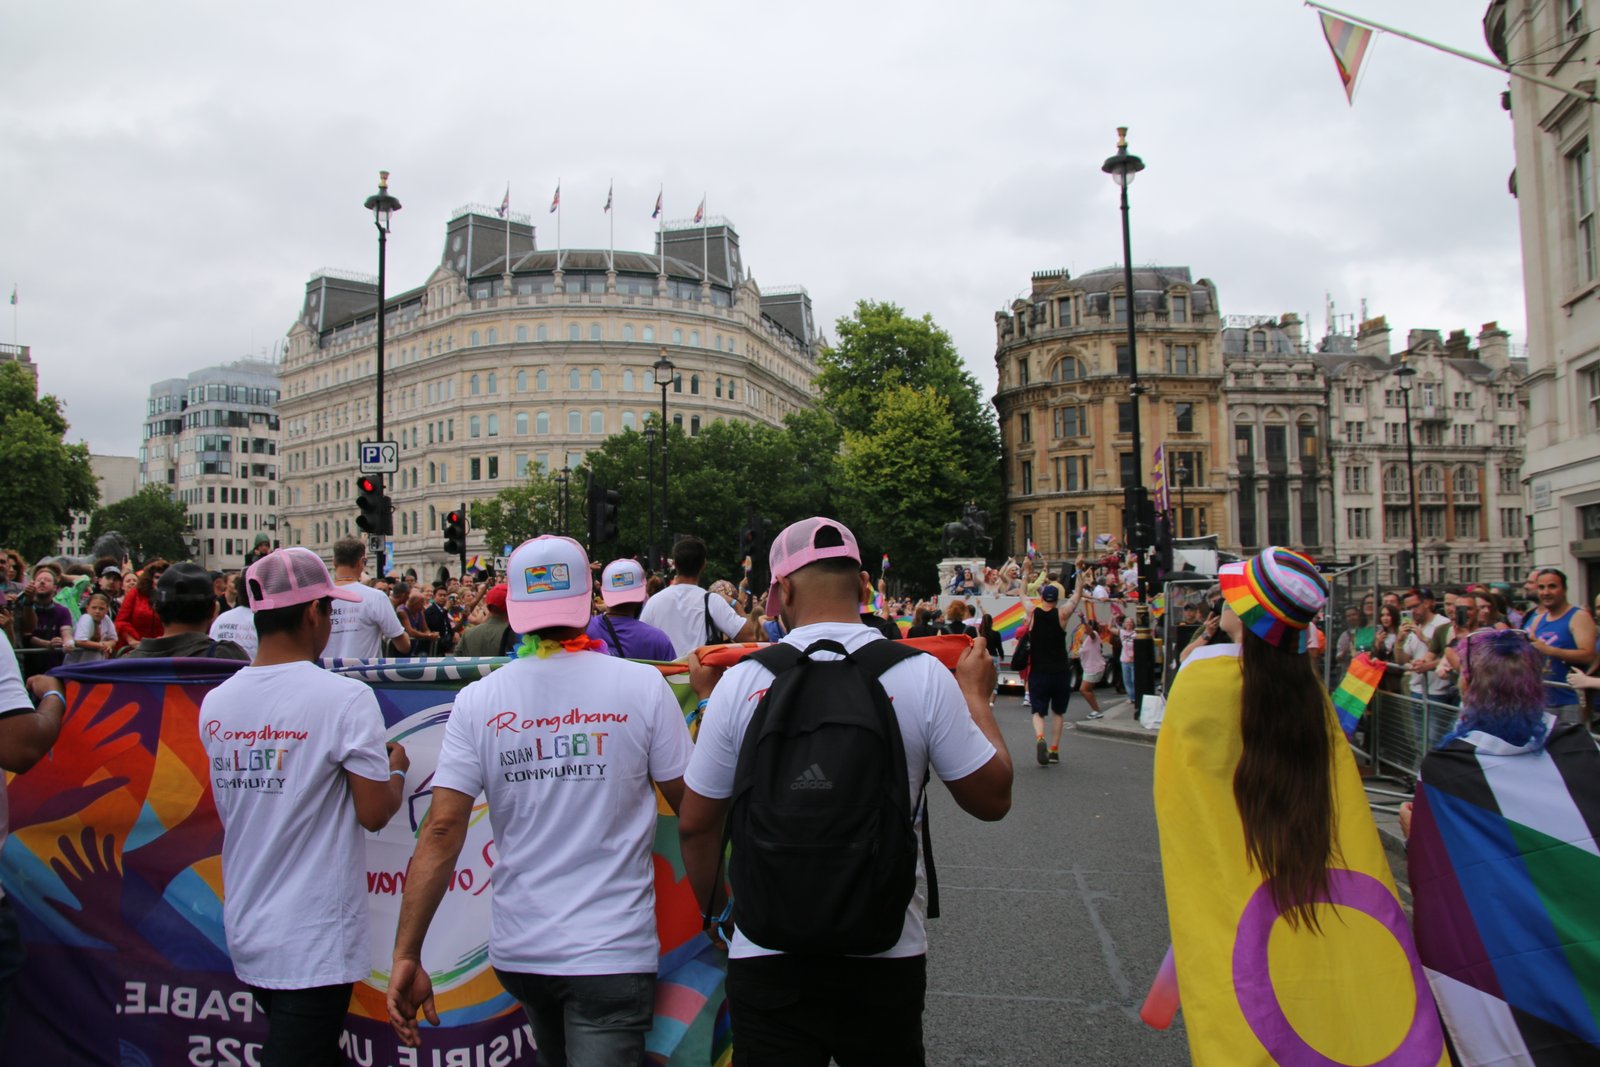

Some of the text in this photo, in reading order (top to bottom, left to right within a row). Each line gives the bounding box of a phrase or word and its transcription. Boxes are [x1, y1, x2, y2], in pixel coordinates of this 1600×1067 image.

[366, 447, 377, 462] P
[204, 719, 309, 747] Rongdhanu
[486, 707, 629, 737] Rongdhanu
[499, 732, 609, 767] ASIAN LGBT
[504, 763, 608, 783] COMMUNITY
[790, 778, 833, 791] adidas
